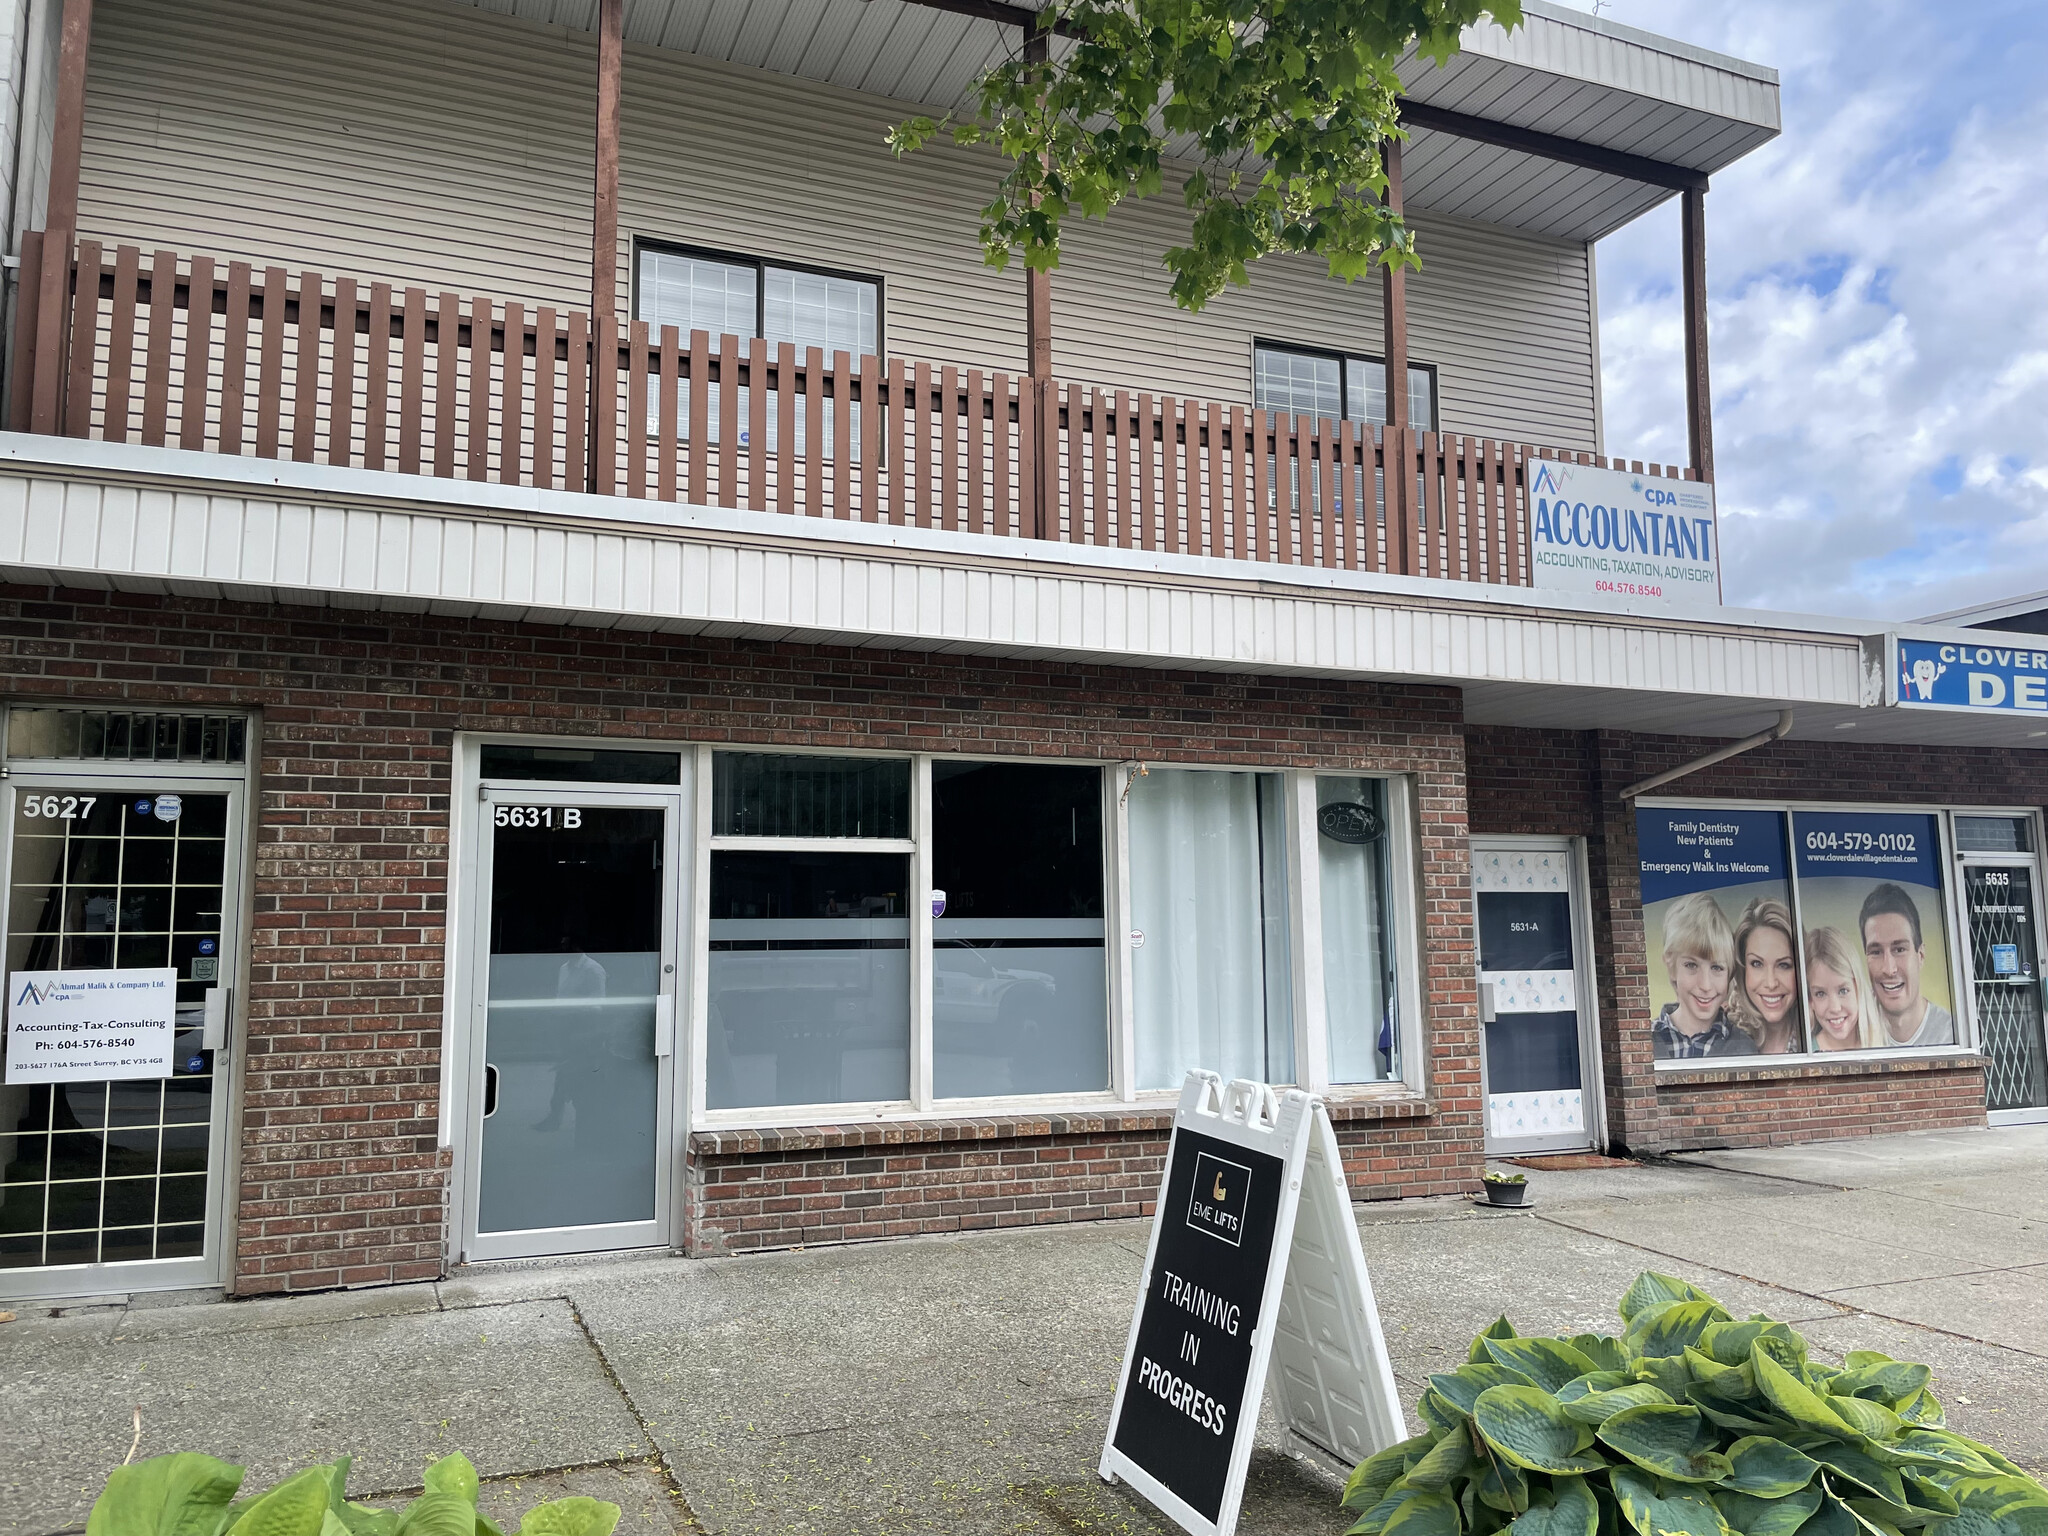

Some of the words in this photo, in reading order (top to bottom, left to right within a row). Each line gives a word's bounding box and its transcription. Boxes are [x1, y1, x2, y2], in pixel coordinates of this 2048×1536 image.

[1534, 498, 1713, 562] ACCOUNTANT
[1536, 551, 1611, 575] ACCOUNTING,
[1611, 559, 1663, 580] TAXATION,
[1664, 566, 1715, 583] ADVISORY
[1595, 580, 1662, 597] 604.576.8540
[1939, 645, 2048, 670] CLOVER
[1968, 671, 2048, 710] DE
[23, 795, 97, 819] 5627
[494, 806, 552, 828] 5631
[563, 808, 582, 829] B
[1323, 812, 1377, 833] OPEN
[1668, 821, 1697, 834] Family
[1699, 822, 1739, 835] Dentistry
[1677, 835, 1696, 845] New
[1698, 835, 1734, 846] Patients
[1806, 831, 1916, 851] 604-579-0102
[1703, 848, 1711, 859] &
[1806, 852, 1918, 864] www.cloverdalevillagedental.com
[1641, 861, 1690, 874] Emergency
[1692, 862, 1715, 872] Walk
[1716, 862, 1729, 872] Ins
[1730, 862, 1770, 873] Welcome
[1985, 872, 2009, 886] 5635
[1510, 922, 1539, 931] 5631-A
[60, 983, 85, 991] Ahmad
[109, 981, 114, 989] &
[117, 981, 150, 990] Company
[15, 1019, 166, 1032] Accounting-Tax-Consulting
[35, 1041, 54, 1050] Ph:
[57, 1038, 135, 1050] 604-576-8540
[1193, 1201, 1213, 1222] EME
[1214, 1209, 1238, 1231] LIFTS
[1163, 1270, 1241, 1337] TRAINING
[1180, 1330, 1201, 1366] IN
[1138, 1356, 1226, 1436] PROGRESS
